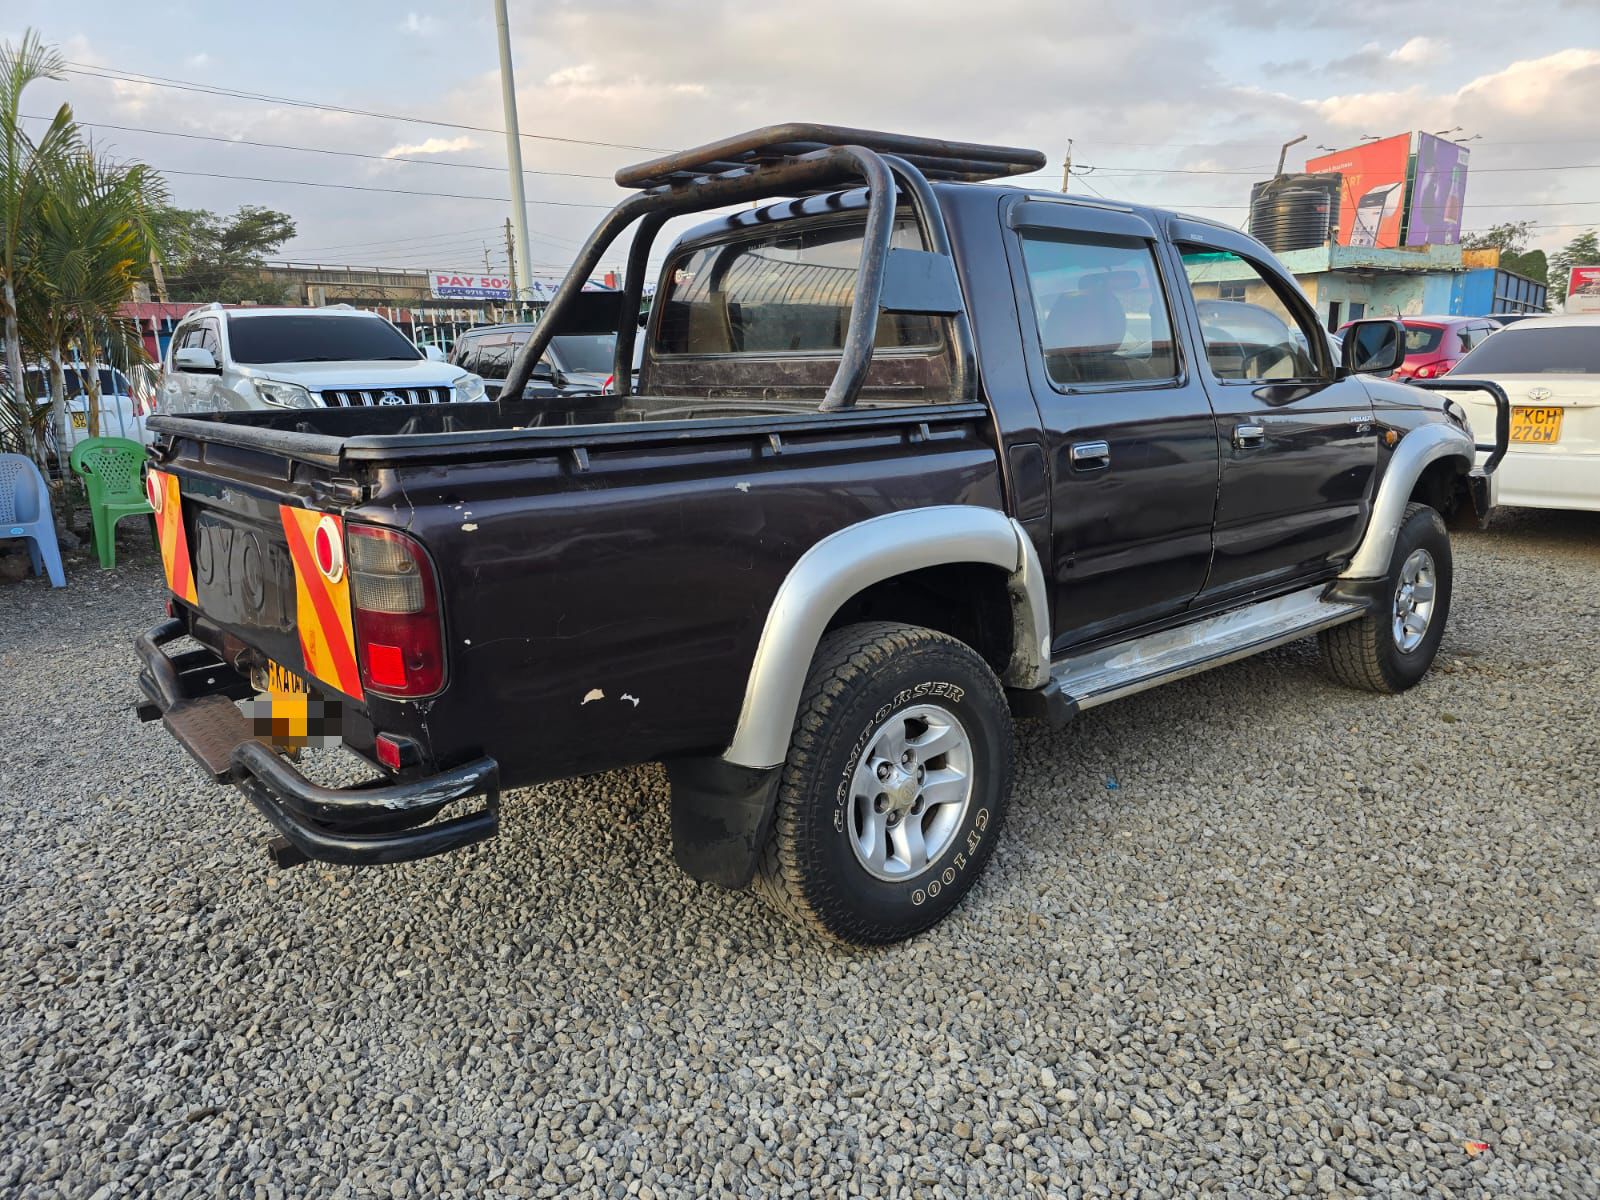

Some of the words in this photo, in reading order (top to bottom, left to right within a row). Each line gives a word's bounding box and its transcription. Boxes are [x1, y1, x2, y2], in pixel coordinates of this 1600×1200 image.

[436, 275, 474, 287] PAY
[1523, 409, 1557, 425] KCH
[1511, 425, 1554, 441] 276W
[195, 518, 293, 627] OYOT
[833, 681, 965, 833] COMFORSER
